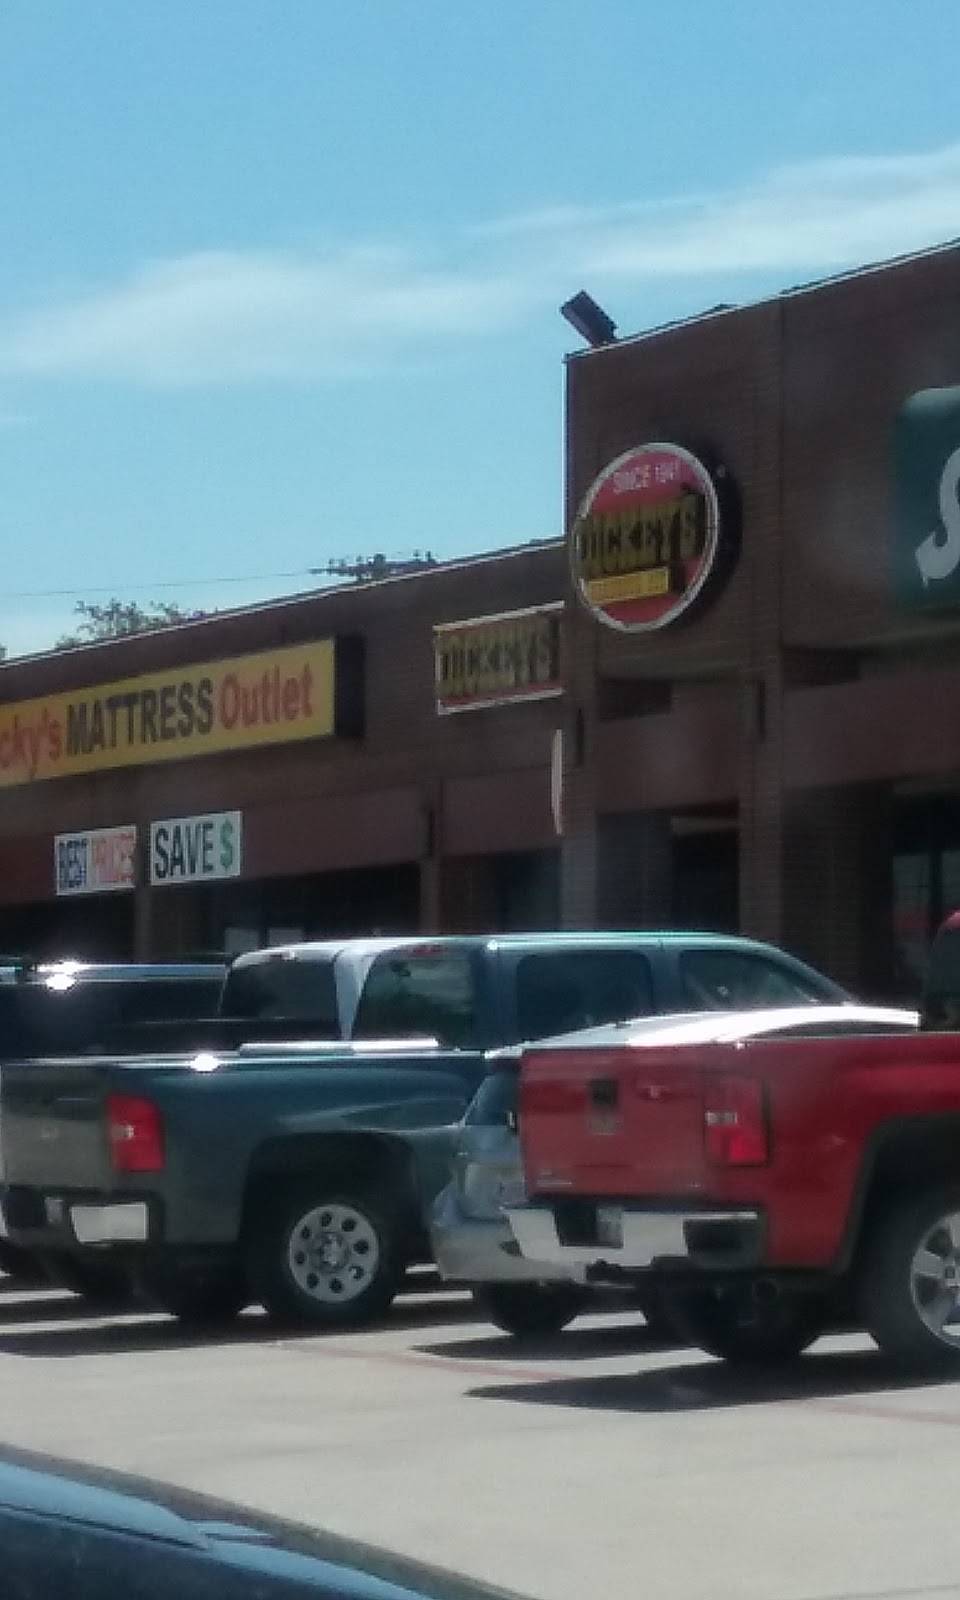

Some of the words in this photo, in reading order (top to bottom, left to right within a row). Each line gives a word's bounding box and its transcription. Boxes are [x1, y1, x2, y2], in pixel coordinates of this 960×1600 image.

[66, 678, 213, 755] MATTRESS
[218, 663, 312, 730] Outlet
[154, 823, 214, 879] SAVE
